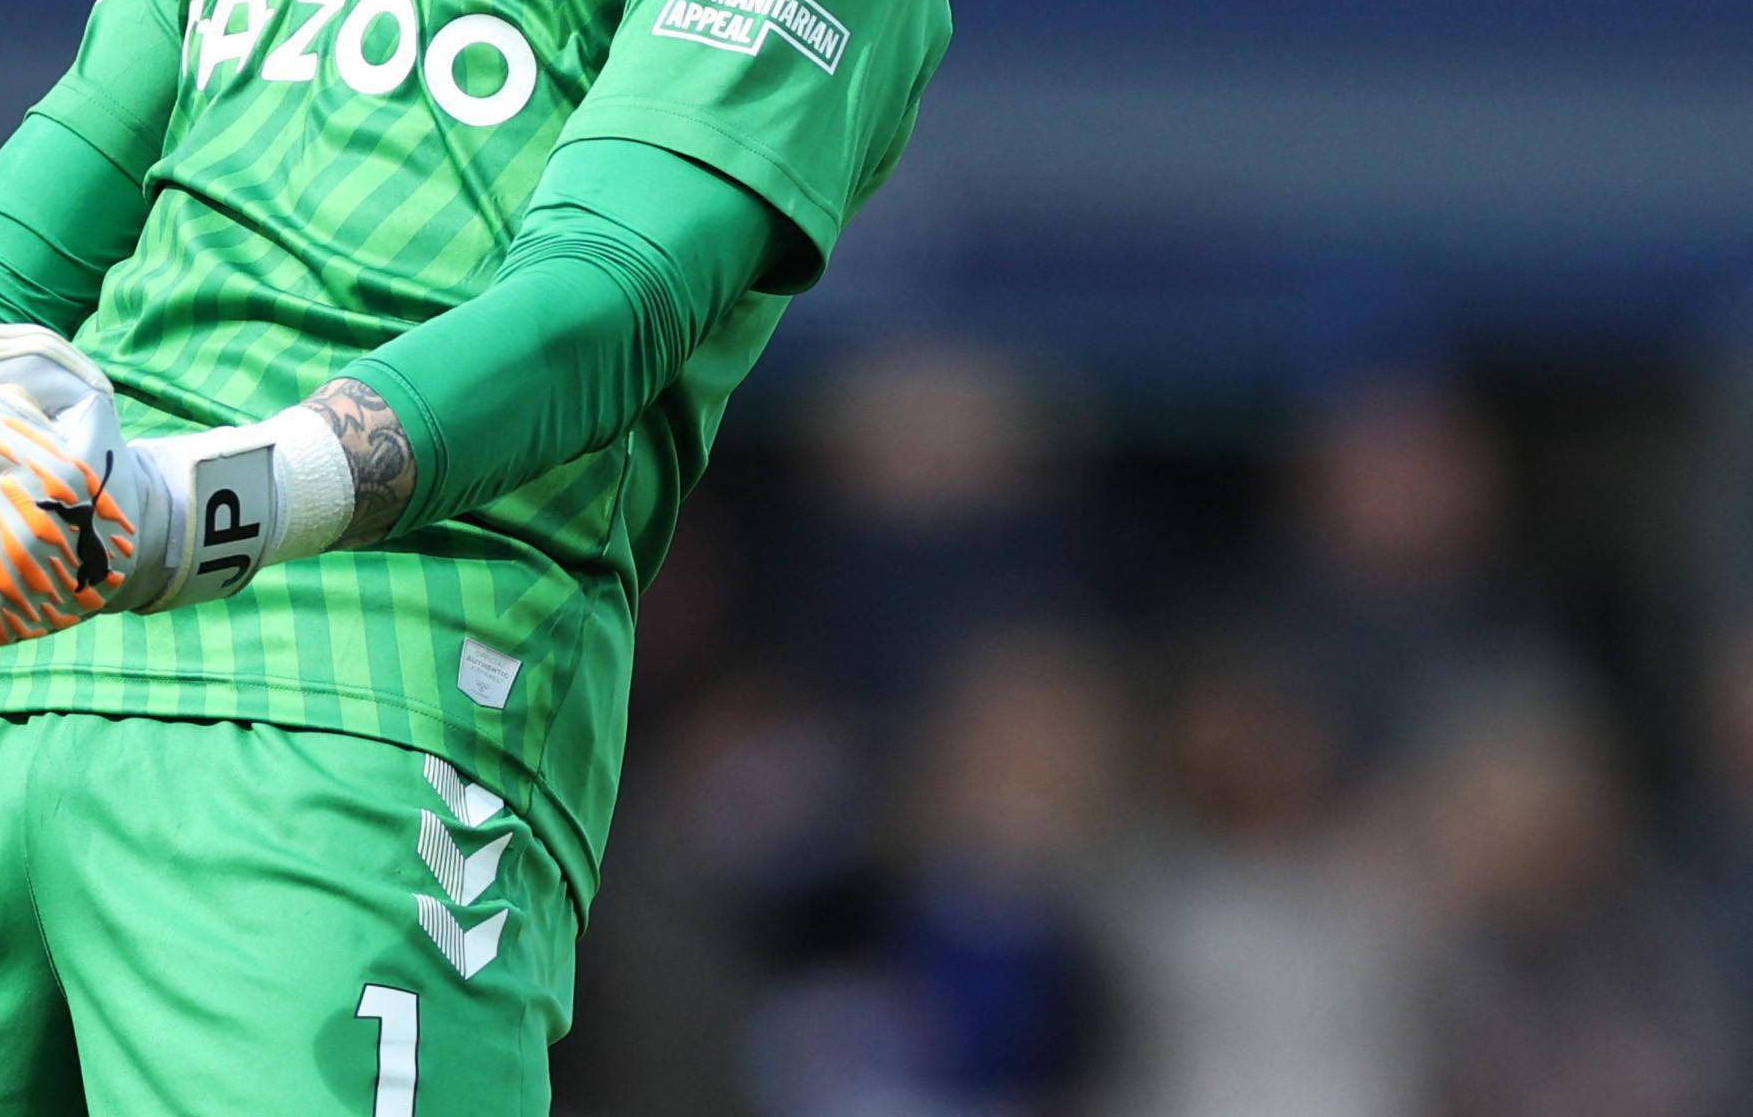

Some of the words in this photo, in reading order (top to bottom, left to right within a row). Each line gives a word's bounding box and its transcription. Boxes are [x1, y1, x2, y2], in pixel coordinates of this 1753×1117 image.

[665, 0, 755, 44] APPEAL
[196, 488, 261, 589] JP
[354, 982, 419, 1117] 1
